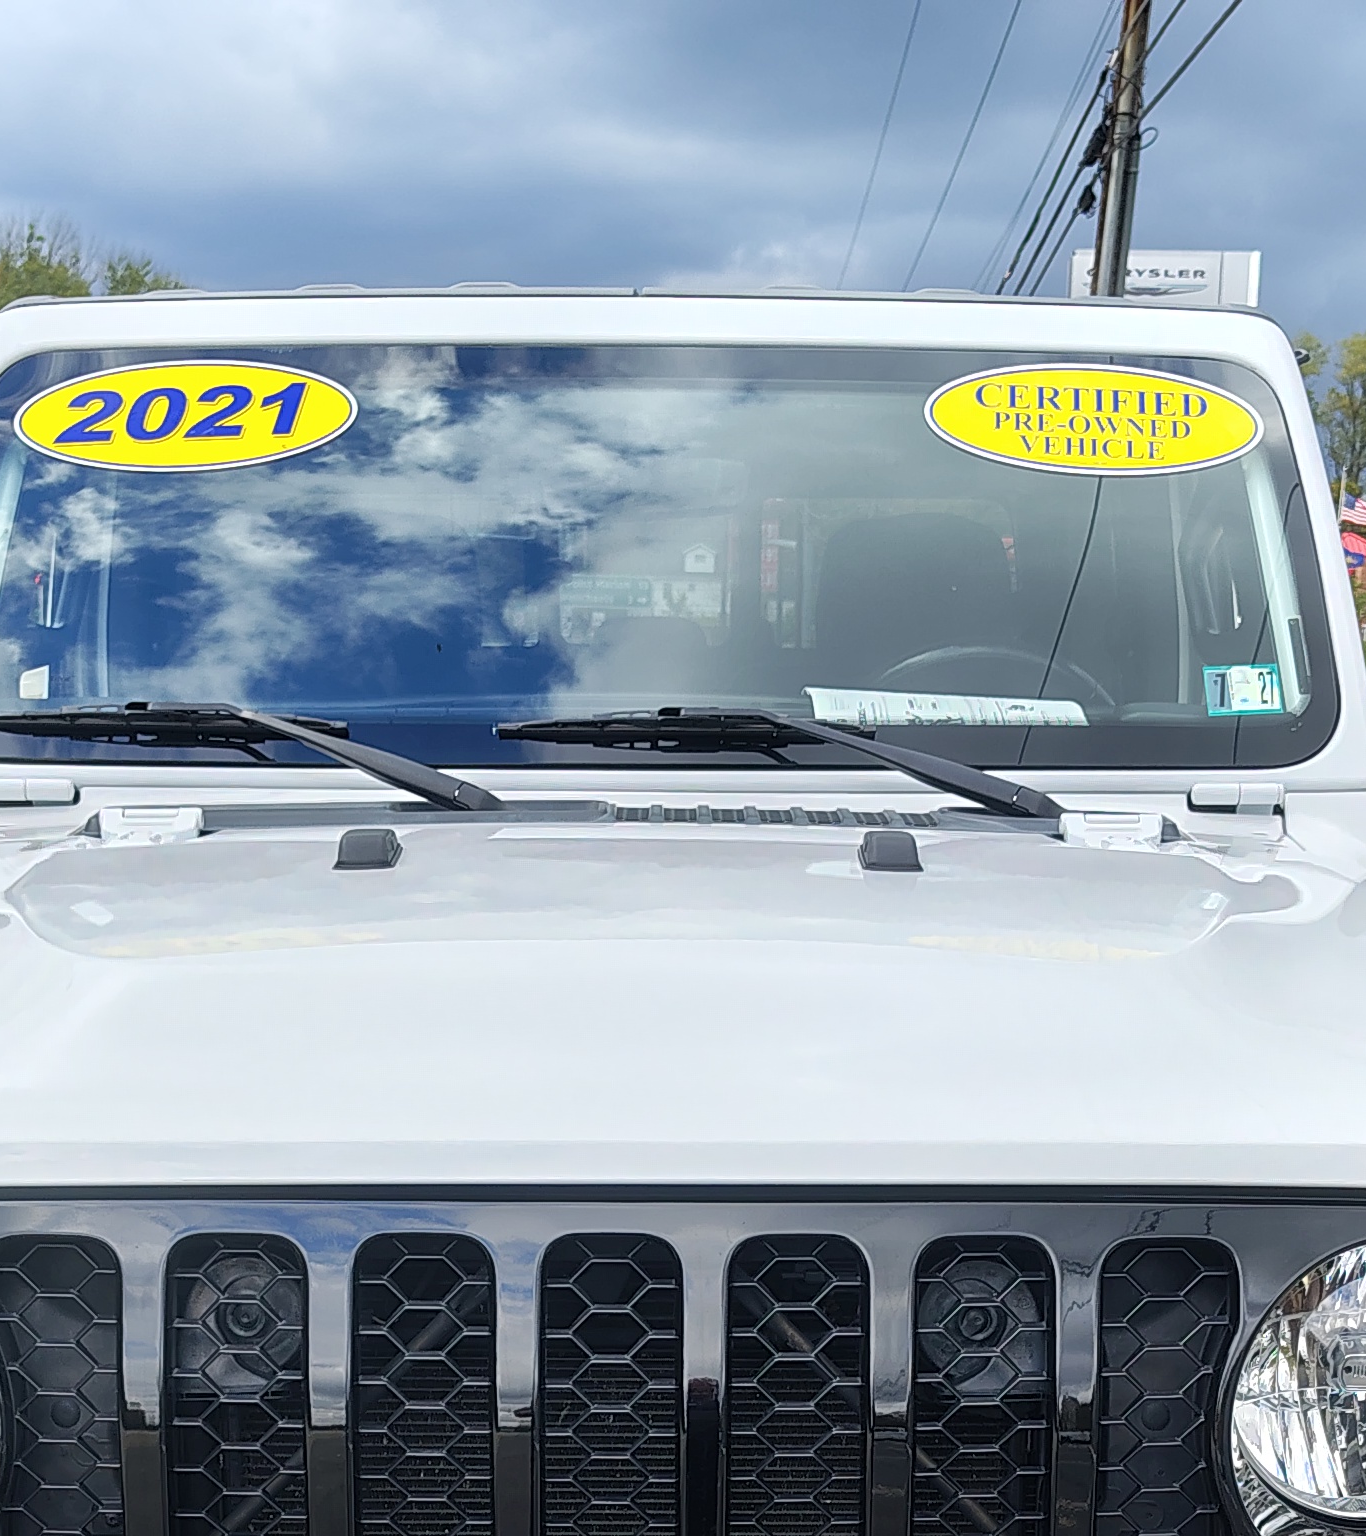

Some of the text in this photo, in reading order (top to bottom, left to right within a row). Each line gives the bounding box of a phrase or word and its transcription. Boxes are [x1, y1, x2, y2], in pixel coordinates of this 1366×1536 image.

[53, 382, 309, 446] 2021
[975, 383, 1208, 418] CERTIFIED
[994, 411, 1191, 439] PRE-OWNED
[1020, 434, 1166, 461] VEHICLE
[1257, 671, 1275, 707] 27
